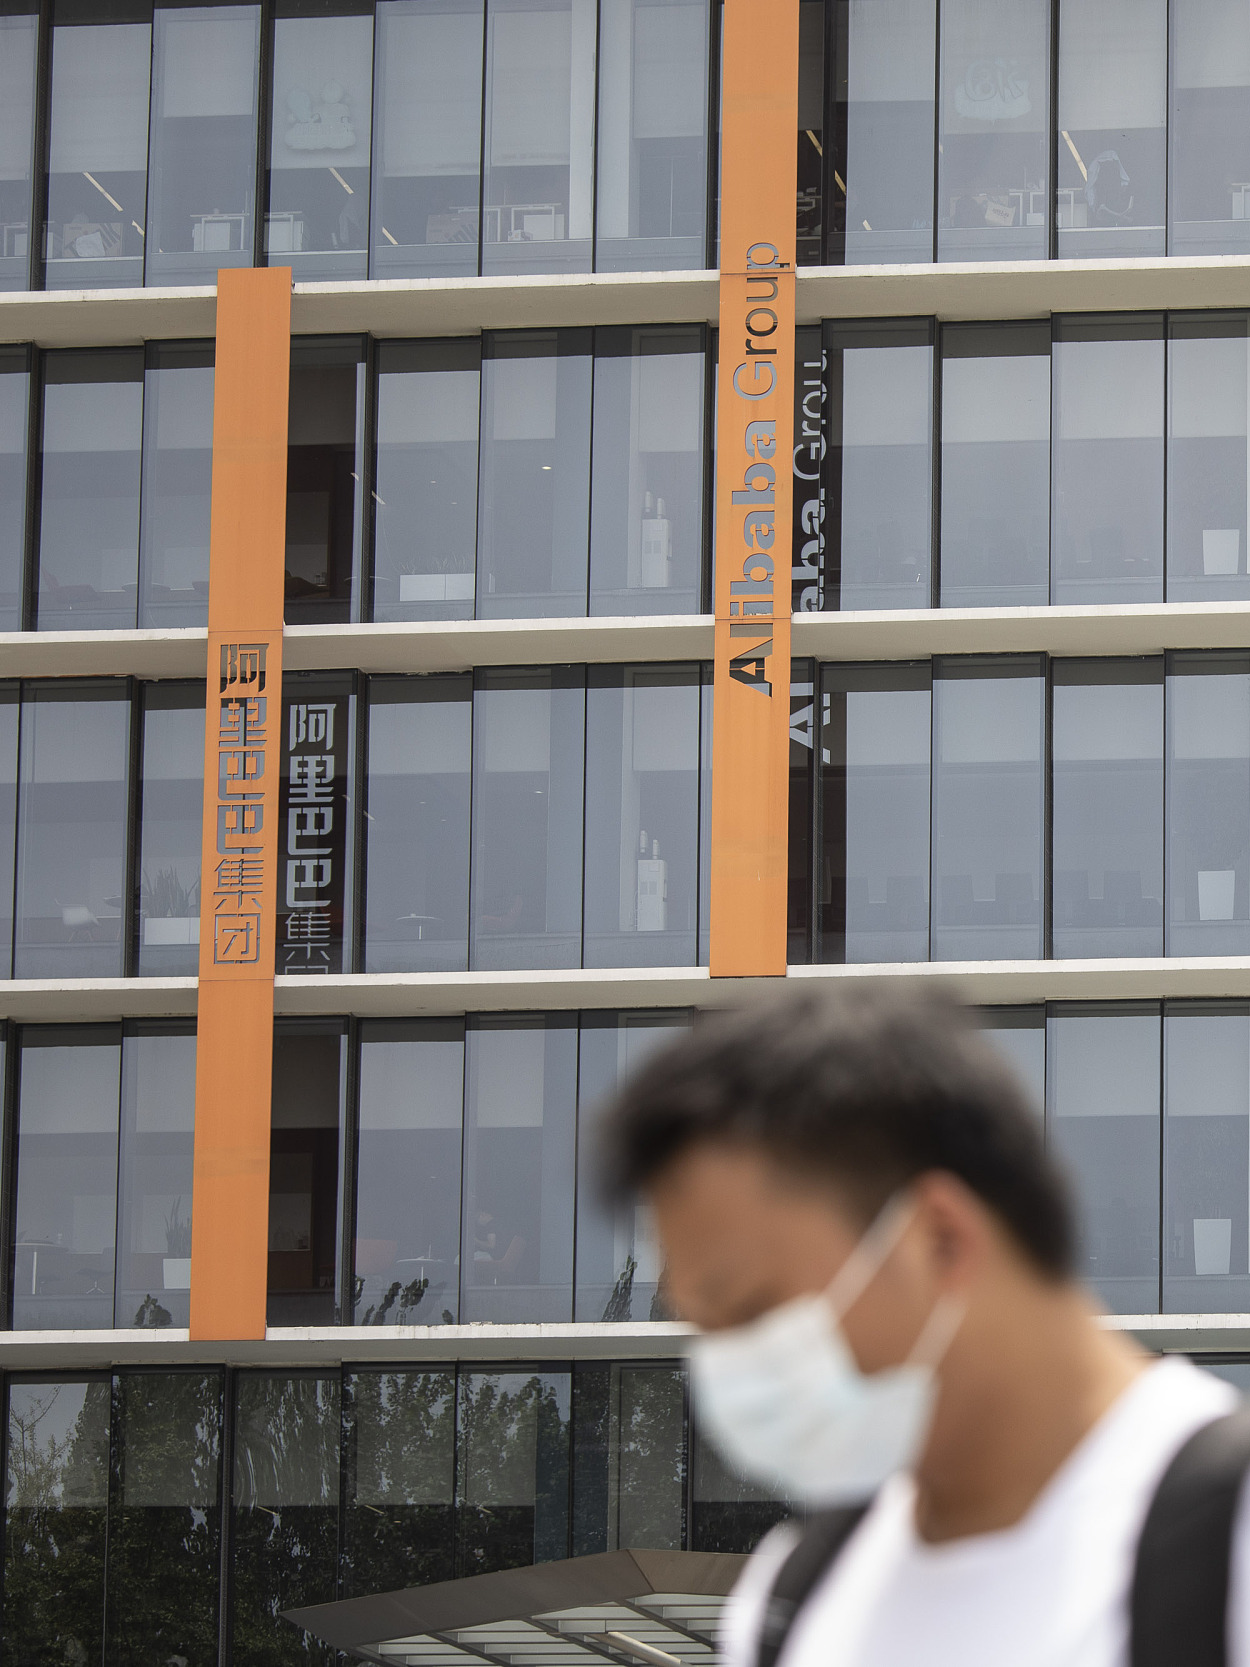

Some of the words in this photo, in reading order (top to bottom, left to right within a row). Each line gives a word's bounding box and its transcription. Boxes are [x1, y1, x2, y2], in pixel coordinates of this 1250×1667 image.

[733, 242, 790, 401] Group
[793, 349, 828, 480] Grou
[729, 420, 777, 697] Alibaba
[789, 488, 830, 765] Alaba
[213, 643, 270, 965] 阿里巴巴集团
